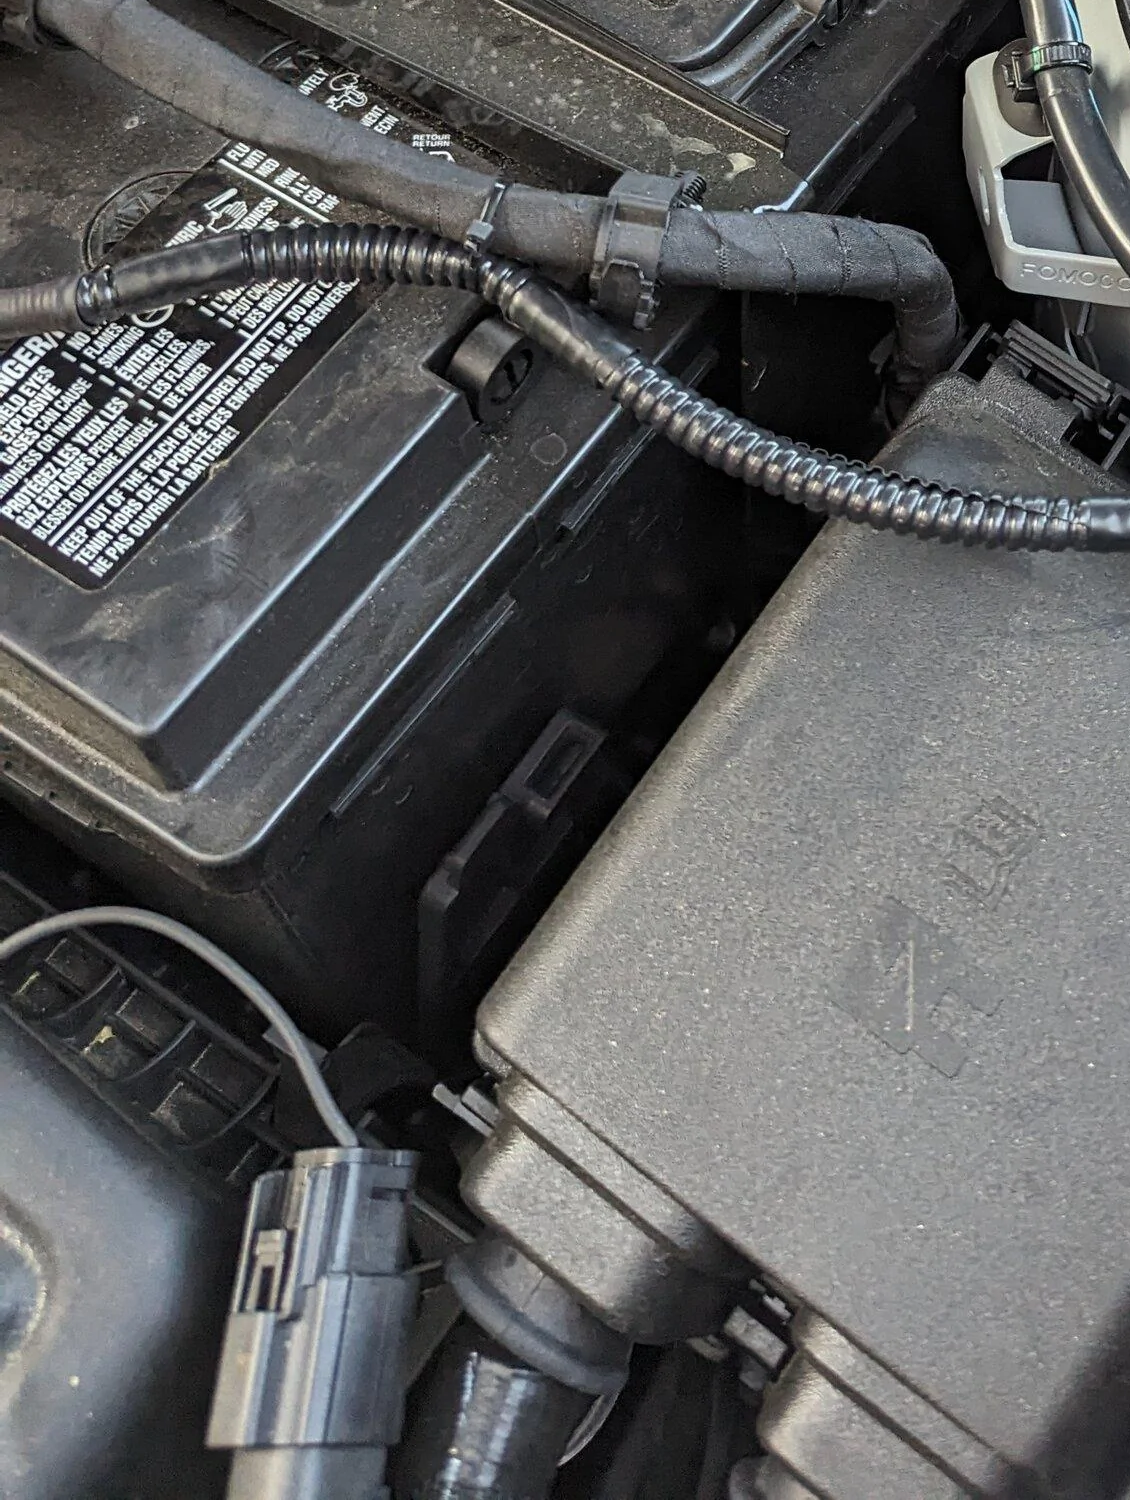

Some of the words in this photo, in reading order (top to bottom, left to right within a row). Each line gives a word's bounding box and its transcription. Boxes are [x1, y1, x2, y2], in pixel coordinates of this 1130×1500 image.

[412, 133, 451, 141] RETOUR
[412, 140, 451, 148] RETURN
[226, 295, 253, 320] PEUT
[241, 308, 266, 328] DES
[66, 331, 91, 350] NO
[82, 322, 128, 359] FLAMES,
[97, 326, 144, 368] SMOKING
[113, 343, 158, 381] ÉVITER
[150, 327, 174, 348] LES
[270, 343, 293, 362] NE
[284, 323, 311, 347] PAS
[18, 365, 54, 397] EYES
[130, 338, 191, 390] ÉTINCELLES,
[147, 378, 172, 399] LES
[163, 338, 215, 383] FLAMMES,
[162, 391, 183, 408] DE
[174, 362, 212, 396] FUMER
[224, 361, 279, 410] ENFANTS.
[0, 382, 61, 444] EXPLOSIVE
[0, 426, 40, 464] GASES
[33, 407, 61, 431] CAN
[53, 377, 92, 411] CAUSE
[36, 433, 59, 452] OR
[51, 398, 93, 437] INJURY
[57, 525, 88, 557] KEEP
[83, 502, 112, 529] OUT
[105, 488, 125, 507] OF
[119, 468, 148, 491] THE
[139, 435, 180, 473] REACH
[172, 421, 192, 439] OF
[185, 374, 242, 425] CHILDREN.
[233, 356, 256, 375] DO
[248, 336, 274, 360] NOT
[265, 321, 293, 339] TIP.
[284, 304, 306, 322] DO
[298, 284, 324, 307] NOT
[204, 406, 232, 431] DES
[0, 461, 62, 520] PROTÉGEZ
[51, 442, 81, 467] LES
[71, 414, 109, 446] YEUX
[99, 396, 128, 420] LES
[160, 427, 213, 471] PORTÉE
[14, 503, 45, 529] GAZ
[34, 452, 95, 509] EXPLOSIFS
[87, 415, 133, 458] PEUVENT
[31, 498, 77, 540] BLESSER
[68, 484, 89, 502] OU
[81, 452, 123, 490] RENDRE
[114, 416, 158, 457] AVEUGLE
[135, 481, 159, 502] DE
[150, 468, 174, 486] LA
[88, 555, 113, 577] NE
[104, 533, 134, 560] PAS
[127, 491, 175, 536] OUVRIR
[167, 477, 190, 495] LA
[181, 424, 239, 480] BATTERIE!
[105, 498, 143, 533] HORS
[72, 529, 113, 565] TENIR
